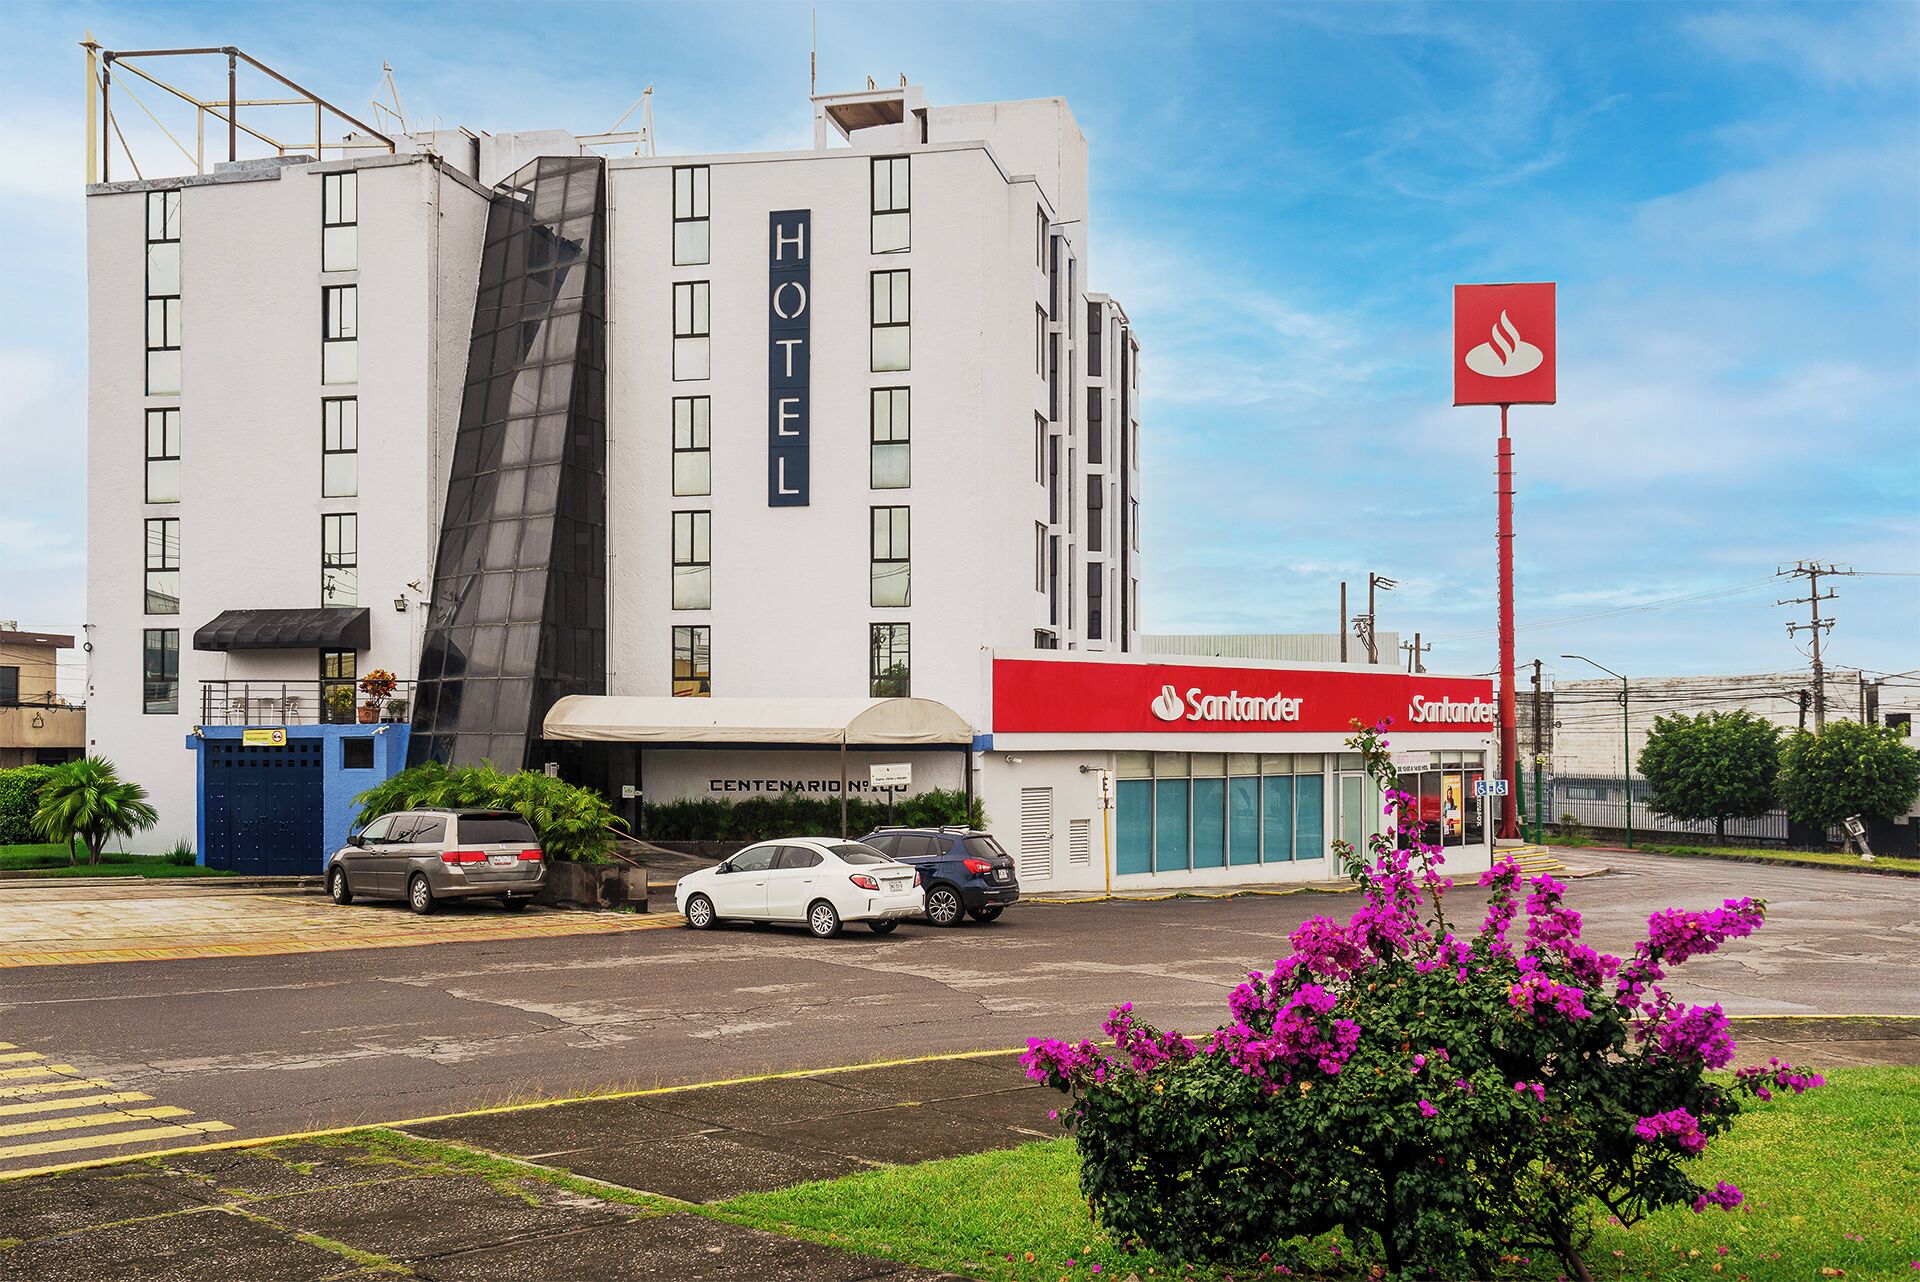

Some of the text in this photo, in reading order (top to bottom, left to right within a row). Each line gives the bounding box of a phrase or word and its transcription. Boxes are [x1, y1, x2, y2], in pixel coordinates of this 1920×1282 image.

[773, 222, 807, 495] HOTEL
[1186, 687, 1304, 722] Santander
[1413, 694, 1494, 723] Santander
[709, 779, 841, 792] CENTENARIO
